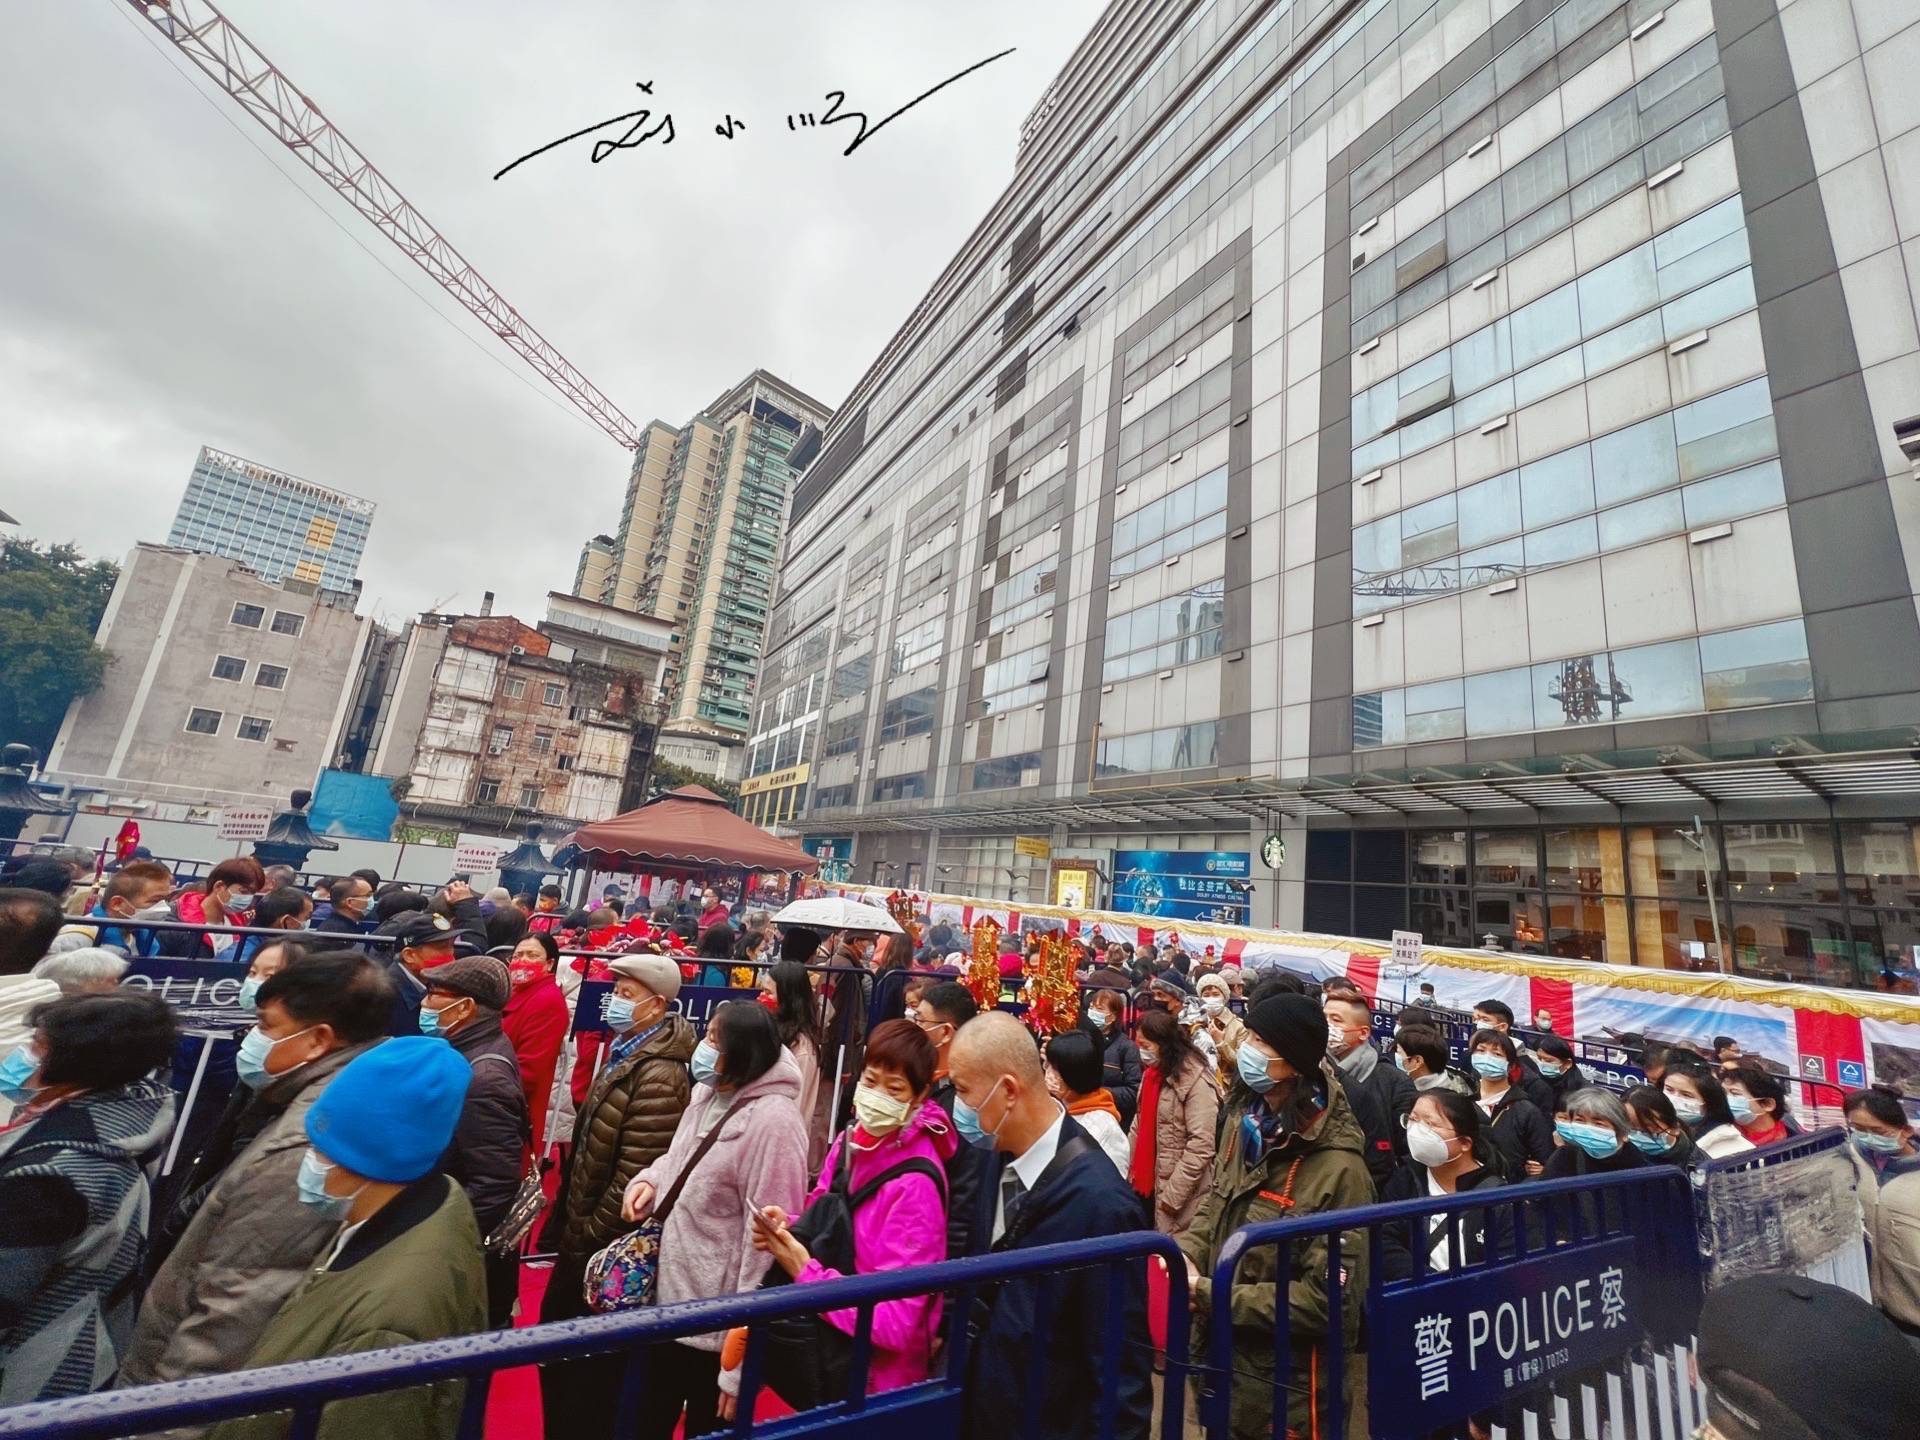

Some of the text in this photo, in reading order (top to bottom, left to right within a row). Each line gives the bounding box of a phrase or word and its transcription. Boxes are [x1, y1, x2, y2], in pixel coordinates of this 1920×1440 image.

[1414, 1265, 1627, 1401] 警 POLICE 察
